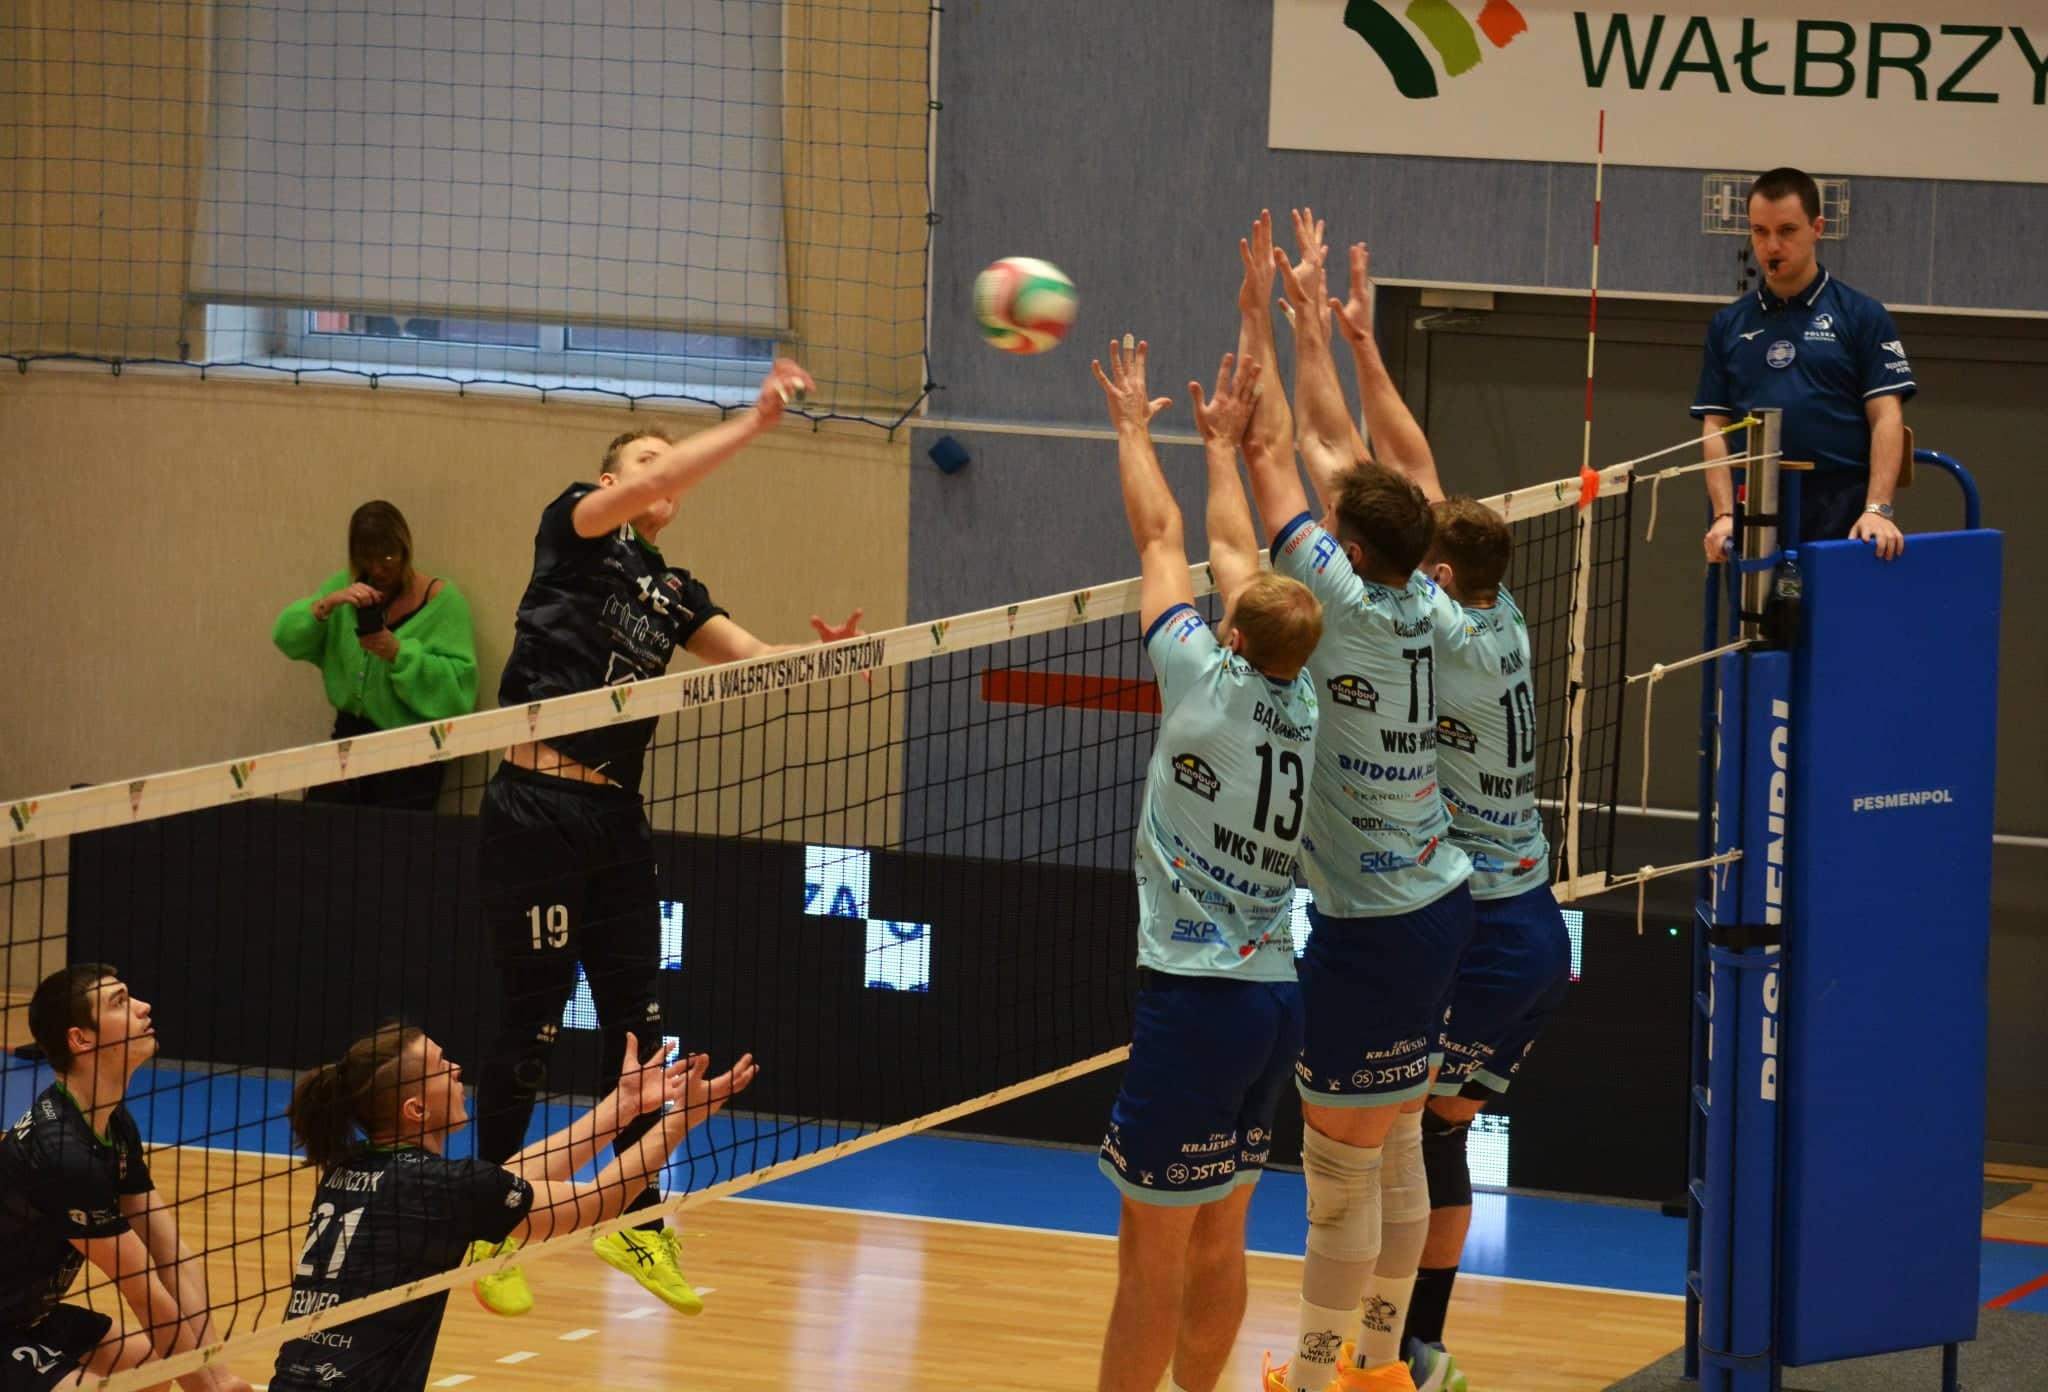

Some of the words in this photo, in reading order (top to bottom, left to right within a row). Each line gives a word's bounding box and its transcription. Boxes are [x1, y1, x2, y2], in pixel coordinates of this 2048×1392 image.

[682, 673, 716, 708] HALA
[719, 655, 814, 699] WAŁBRZYSKICH
[818, 636, 887, 680] MISTRZÓW
[1330, 682, 1377, 702] oknobud
[1380, 728, 1417, 755] WKS
[1499, 680, 1537, 768] 10
[1174, 760, 1218, 789] oknobud
[1255, 741, 1304, 842] 13
[1478, 771, 1514, 800] WKS
[1852, 788, 1953, 812] PESMENPOL
[1213, 822, 1258, 866] WKS
[526, 903, 570, 950] 19
[1173, 918, 1218, 937] SKP
[296, 1201, 366, 1280] 21
